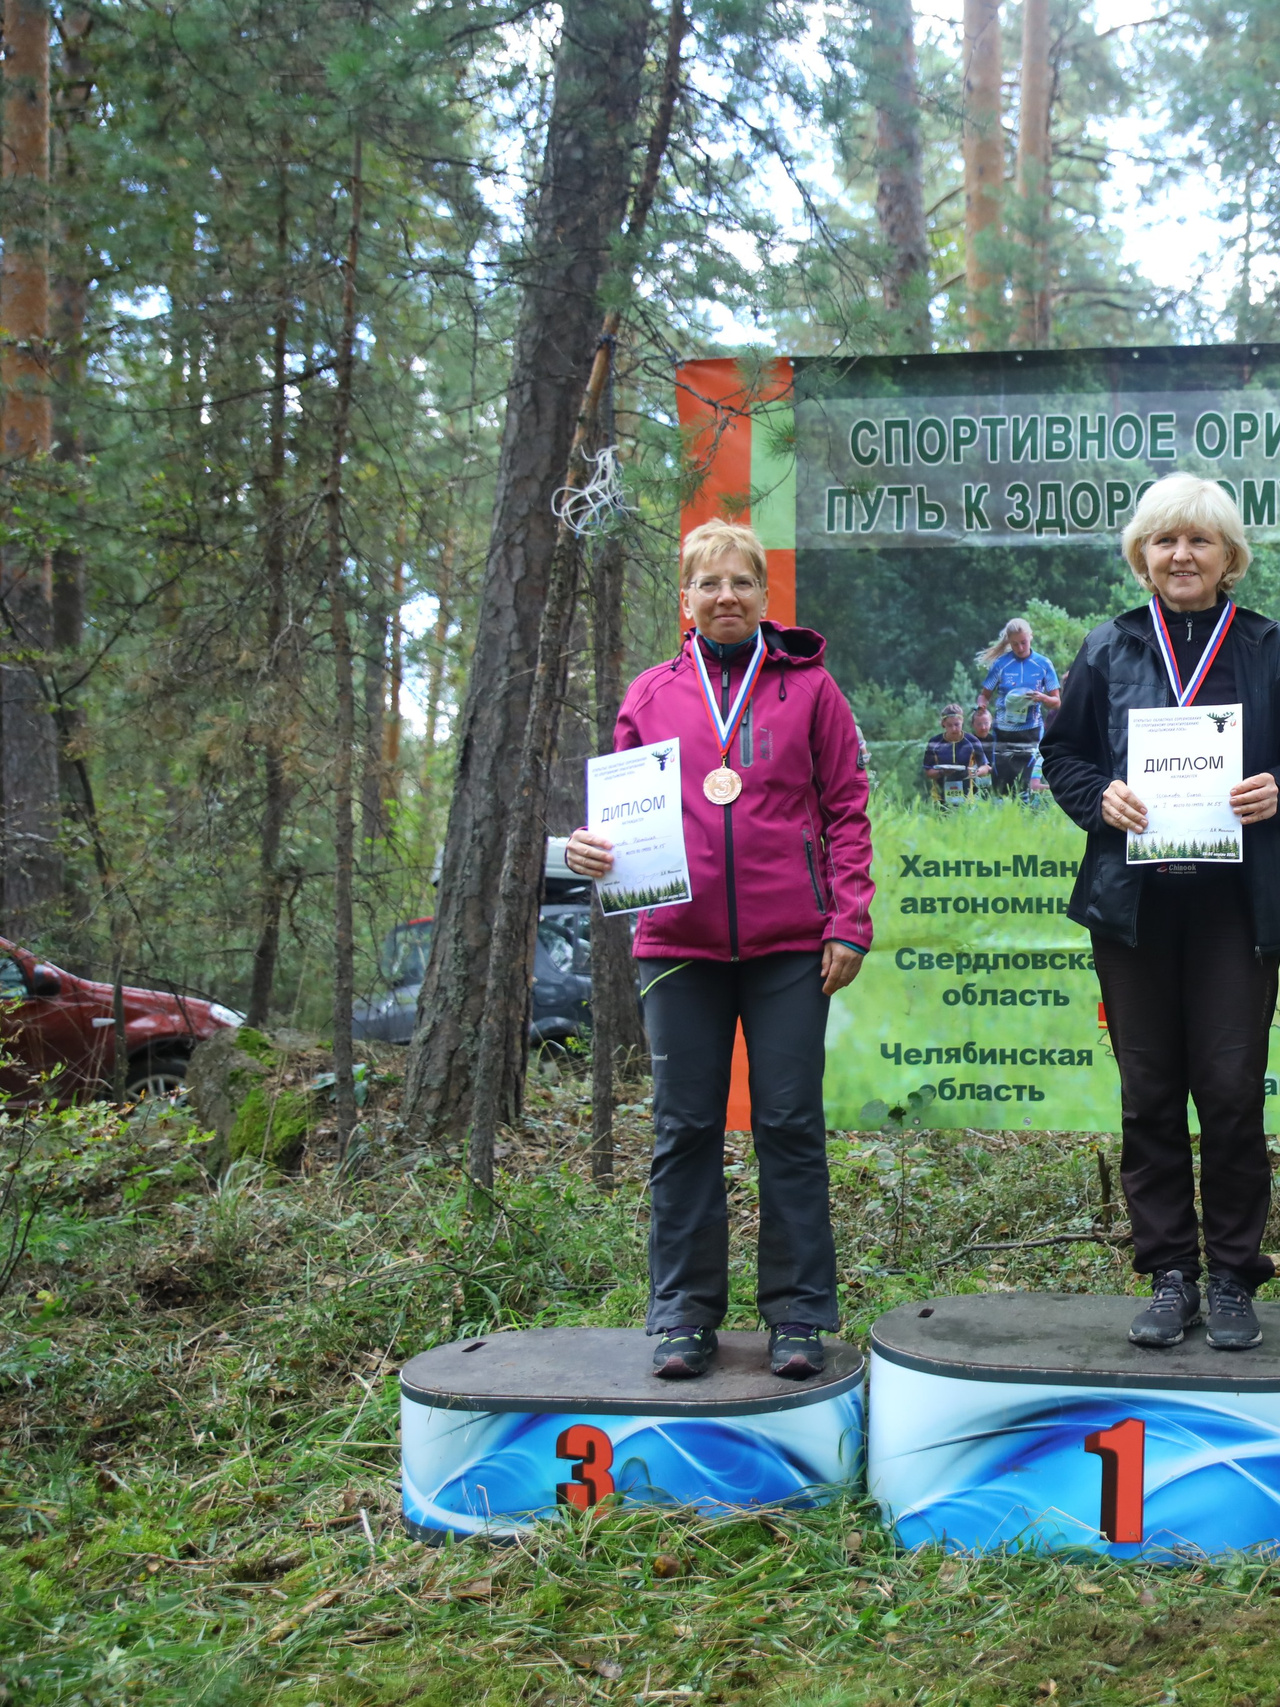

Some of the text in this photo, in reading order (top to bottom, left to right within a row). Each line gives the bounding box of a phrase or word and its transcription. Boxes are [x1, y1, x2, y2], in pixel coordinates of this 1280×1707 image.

[850, 412, 1176, 467] СПОРТИВНОЕ
[825, 485, 946, 533] ПУТЬ
[963, 482, 991, 531] К
[1143, 755, 1224, 773] ДИПЛОМ
[601, 795, 666, 823] ДИПЛОМ
[900, 855, 1078, 878] Ханты-Ман
[1168, 863, 1197, 871] Chinook
[895, 948, 1098, 975] Свердловска
[942, 983, 1070, 1006] область
[880, 1042, 1093, 1066] Челябинская
[556, 1423, 615, 1519] 3
[1084, 1417, 1146, 1543] 1
